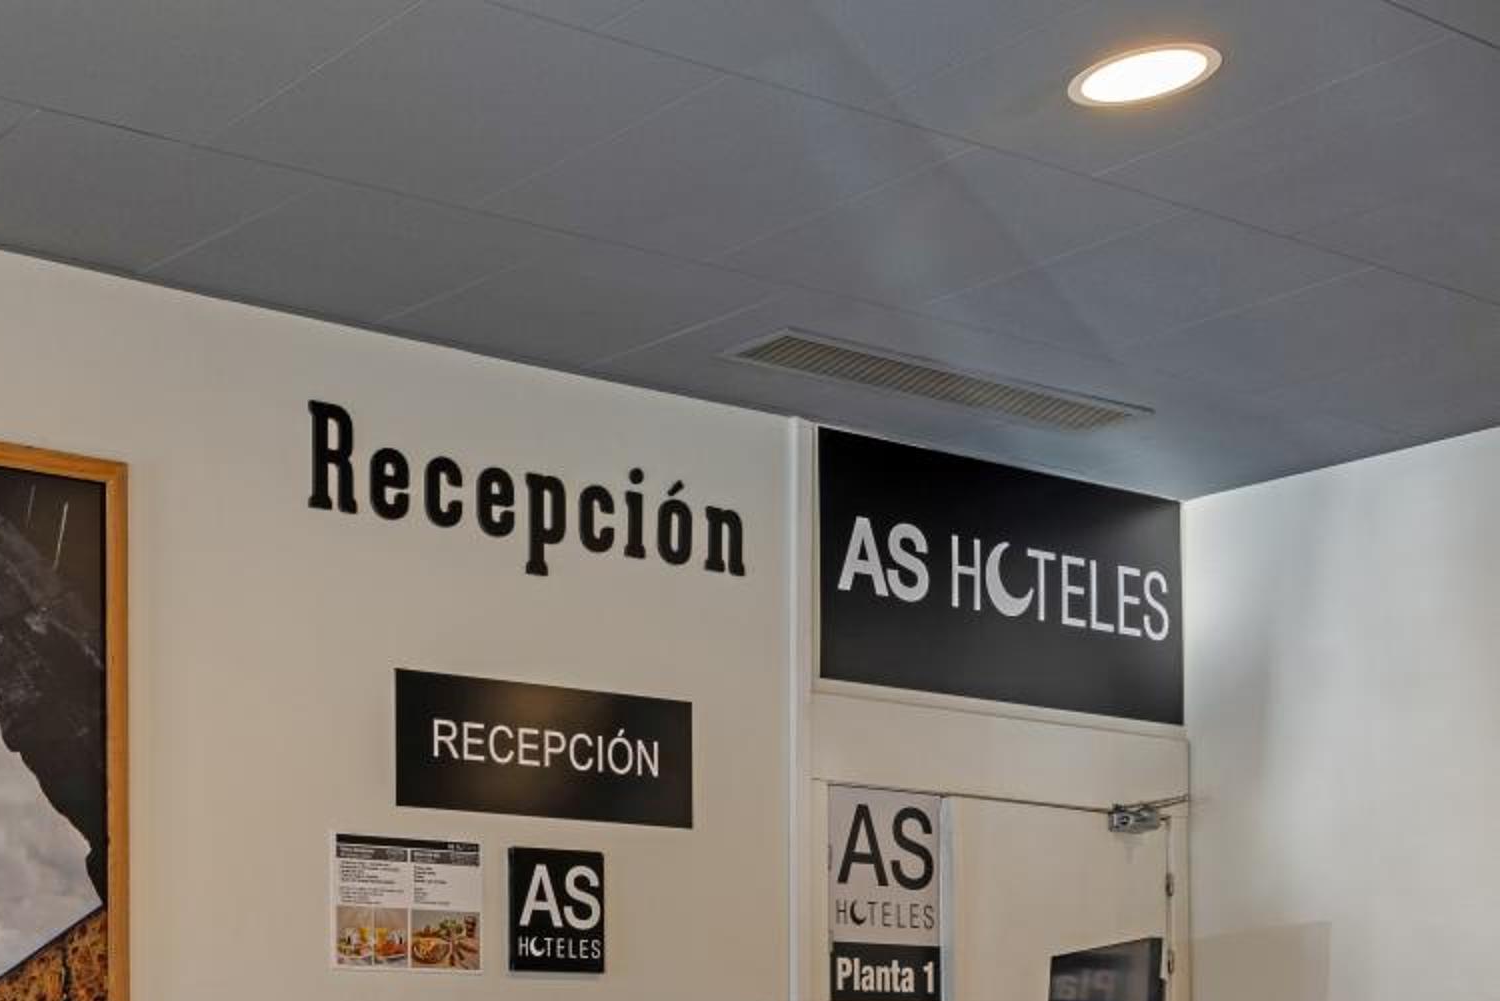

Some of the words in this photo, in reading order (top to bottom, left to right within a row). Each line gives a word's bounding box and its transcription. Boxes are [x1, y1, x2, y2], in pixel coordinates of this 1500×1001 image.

[307, 399, 746, 577] Recepción
[837, 515, 930, 602] AS
[432, 718, 660, 778] RECEPCIÓN
[836, 803, 935, 891] AS
[518, 863, 601, 931] AS
[836, 956, 916, 994] Planta
[923, 960, 935, 994] 1
